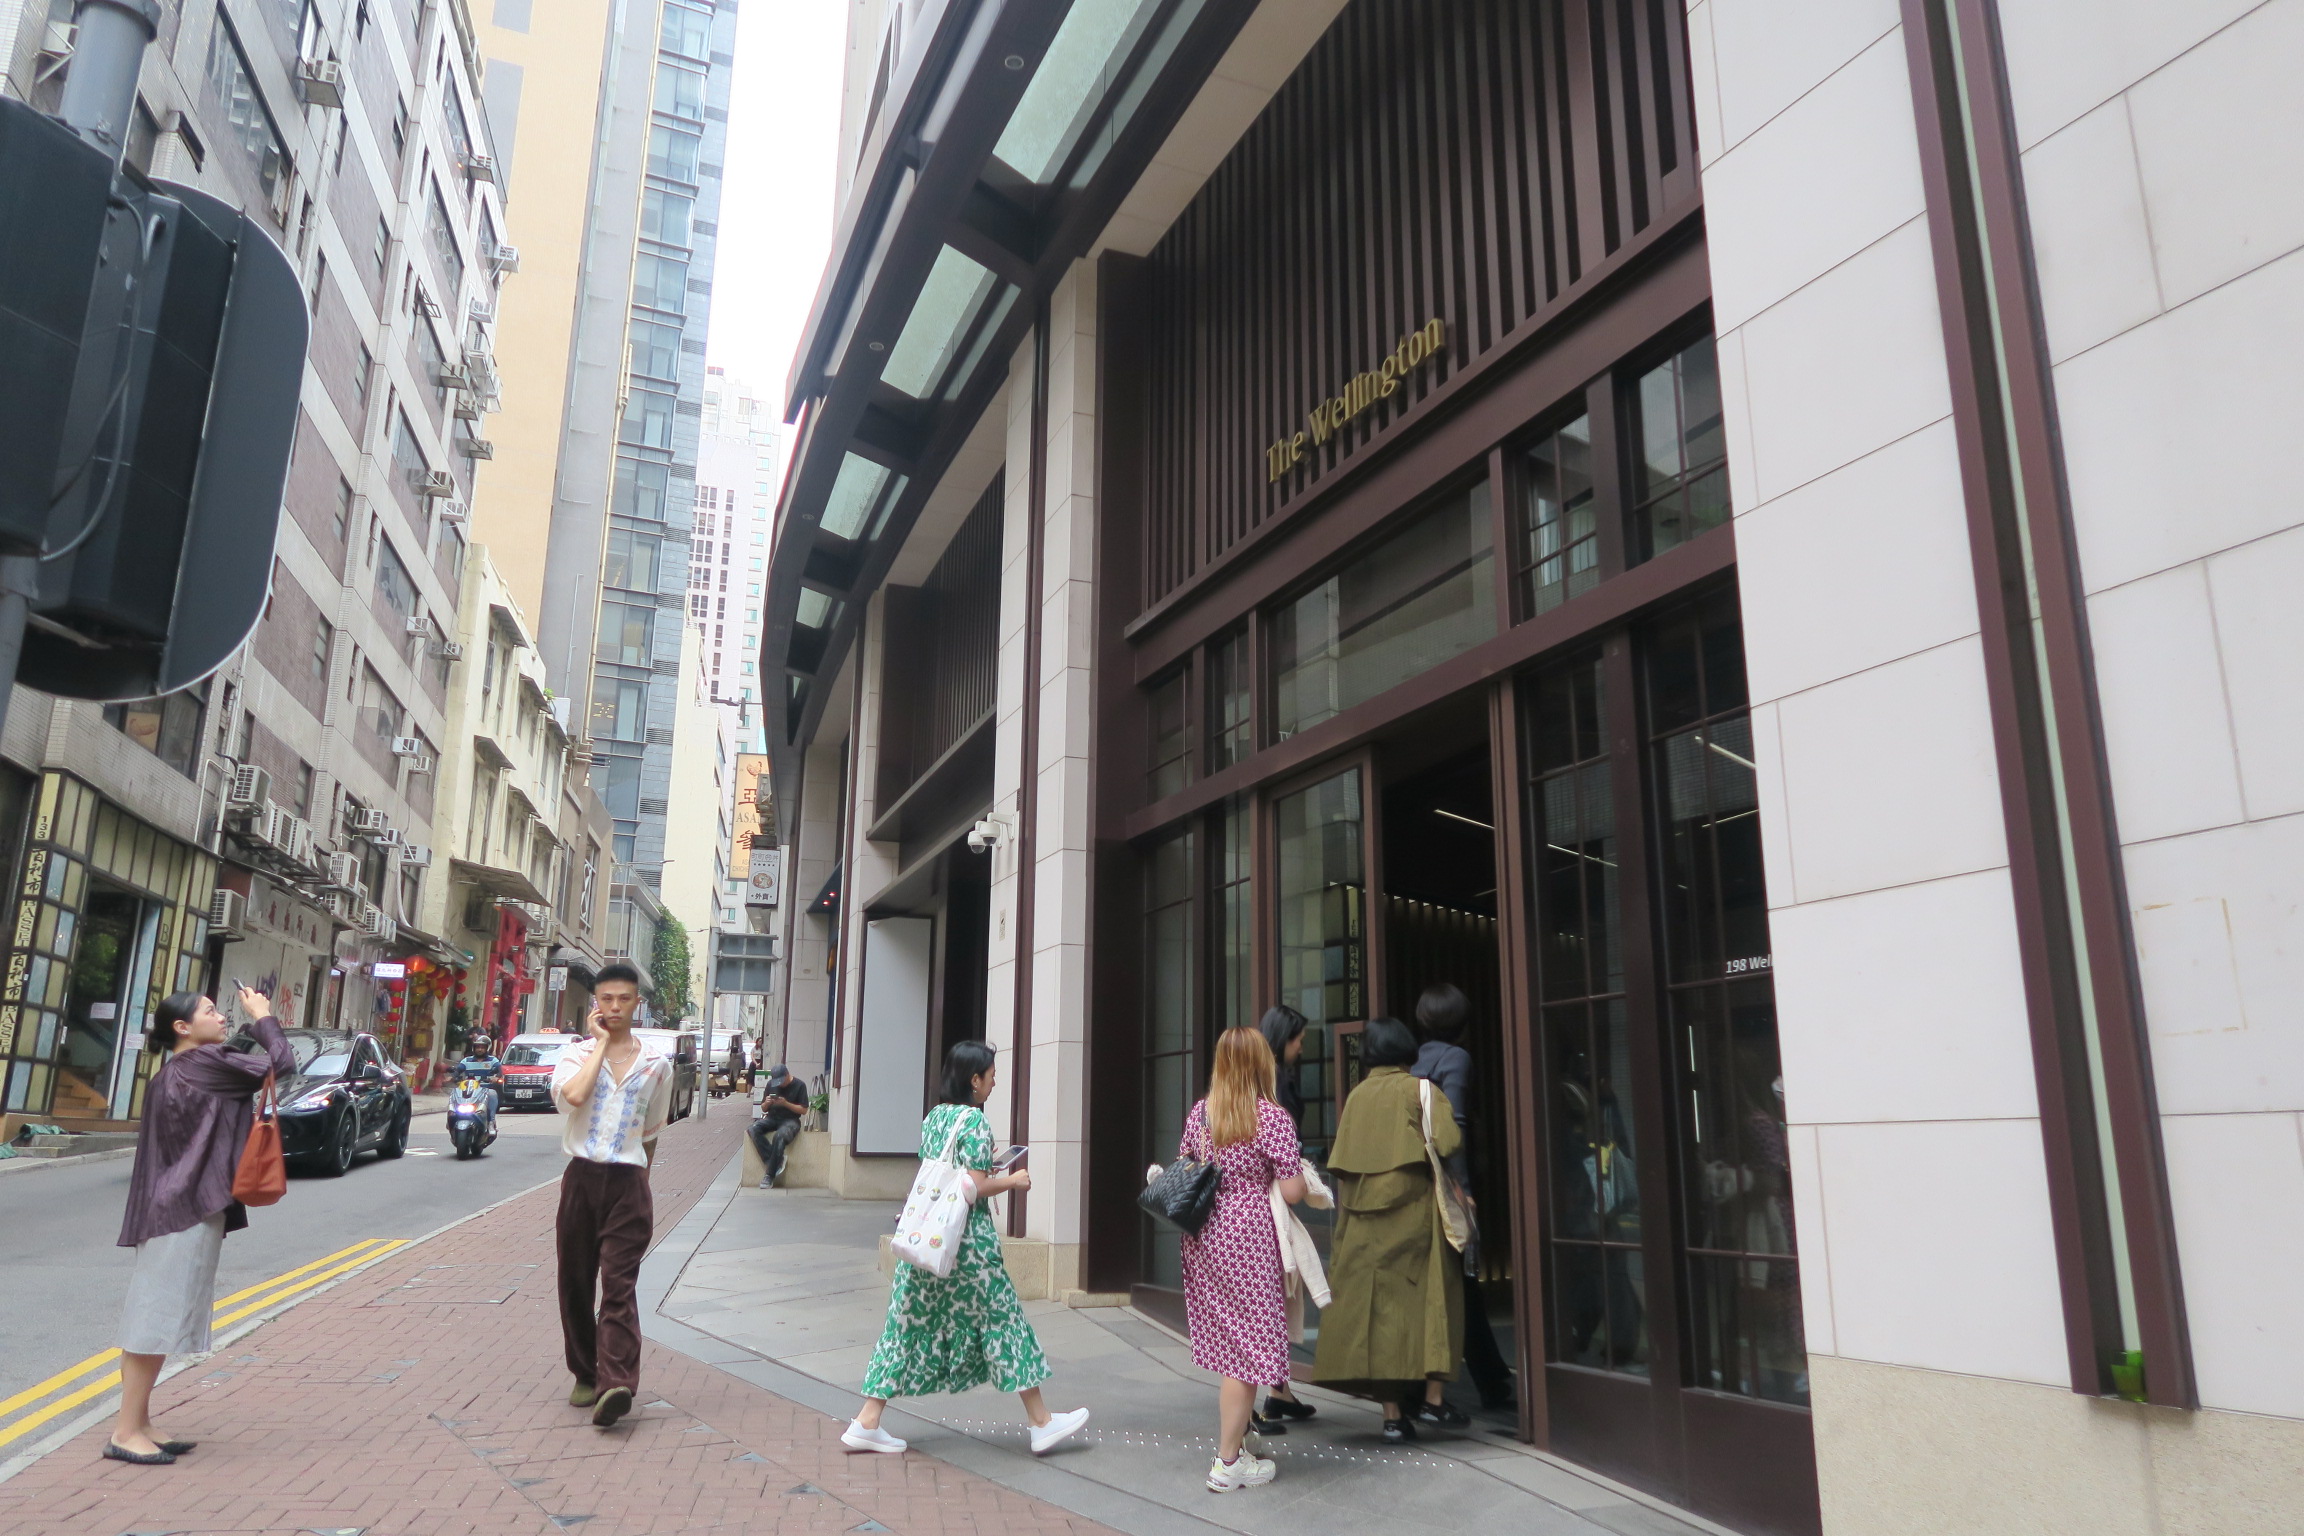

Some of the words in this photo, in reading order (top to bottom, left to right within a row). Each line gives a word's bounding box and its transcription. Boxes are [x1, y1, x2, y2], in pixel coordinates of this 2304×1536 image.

[1267, 431, 1308, 483] The
[1308, 317, 1445, 447] Wellington
[38, 815, 48, 839] 133
[735, 811, 760, 824] ASA
[1726, 958, 1747, 973] 198
